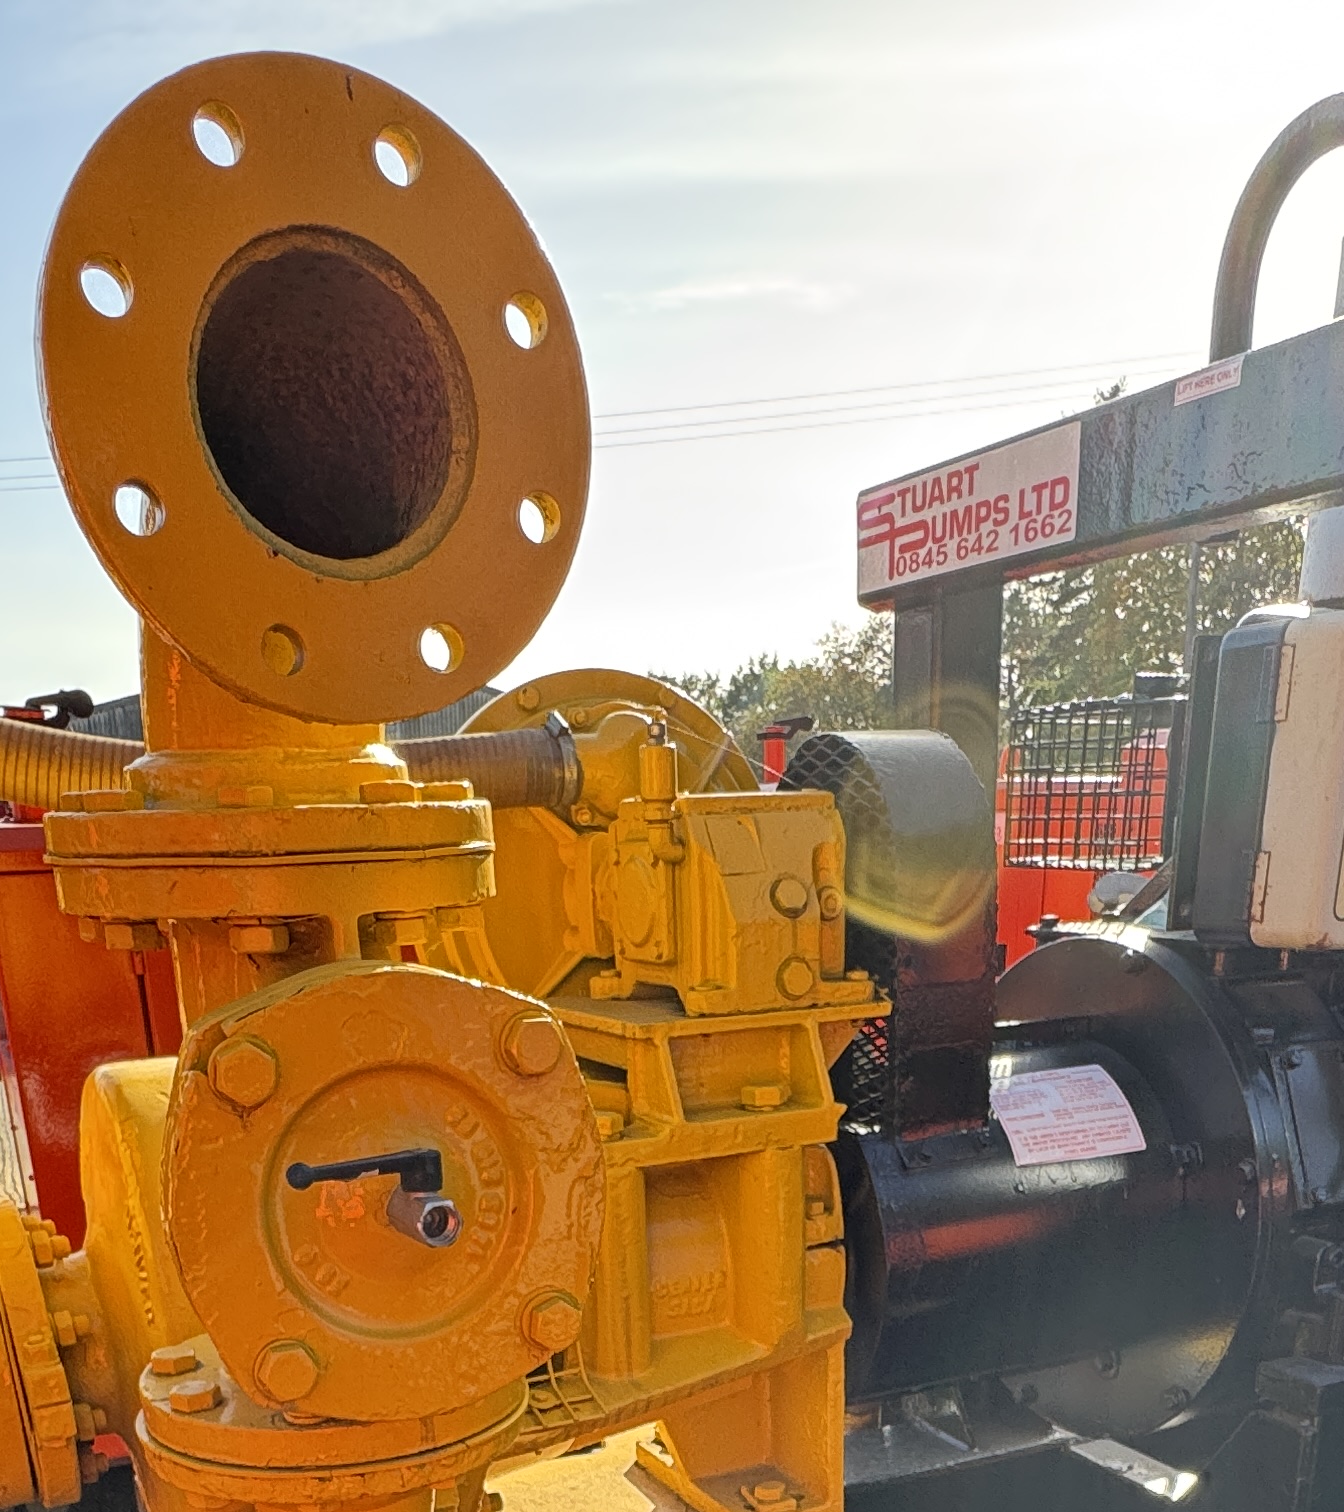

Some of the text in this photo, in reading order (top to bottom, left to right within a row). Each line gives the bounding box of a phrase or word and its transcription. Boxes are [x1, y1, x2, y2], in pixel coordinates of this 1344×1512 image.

[1177, 364, 1240, 396] LIFT HERE ONLY
[858, 462, 980, 549] STUART
[887, 475, 1071, 580] PUMPS LTD
[895, 508, 1073, 577] 0845 642 1662
